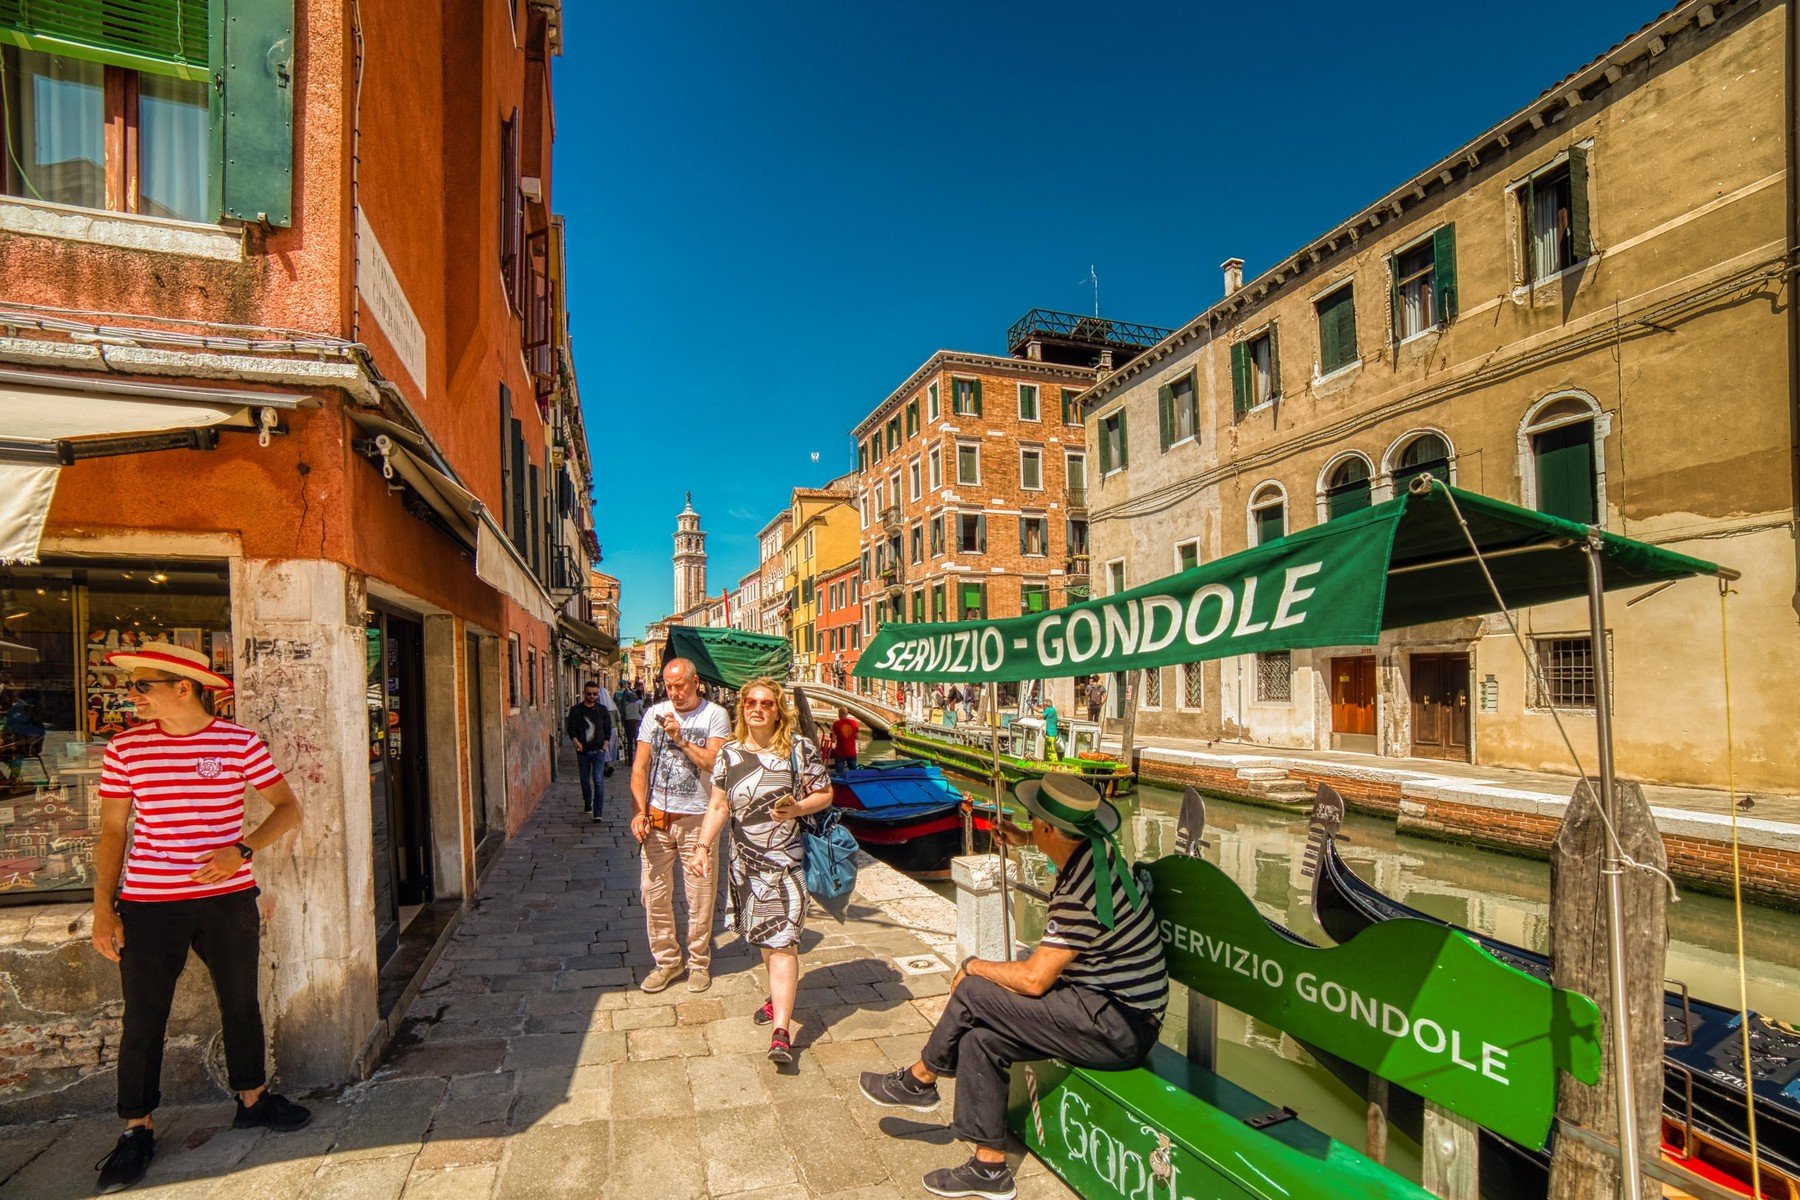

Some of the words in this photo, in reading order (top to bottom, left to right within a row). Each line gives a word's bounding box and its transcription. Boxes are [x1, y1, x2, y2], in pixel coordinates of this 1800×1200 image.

[875, 626, 1004, 672] SERVIZIO
[1036, 561, 1322, 666] GONDOLE
[1160, 919, 1284, 988] SERVIZIO
[1295, 972, 1510, 1086] GONDOLE
